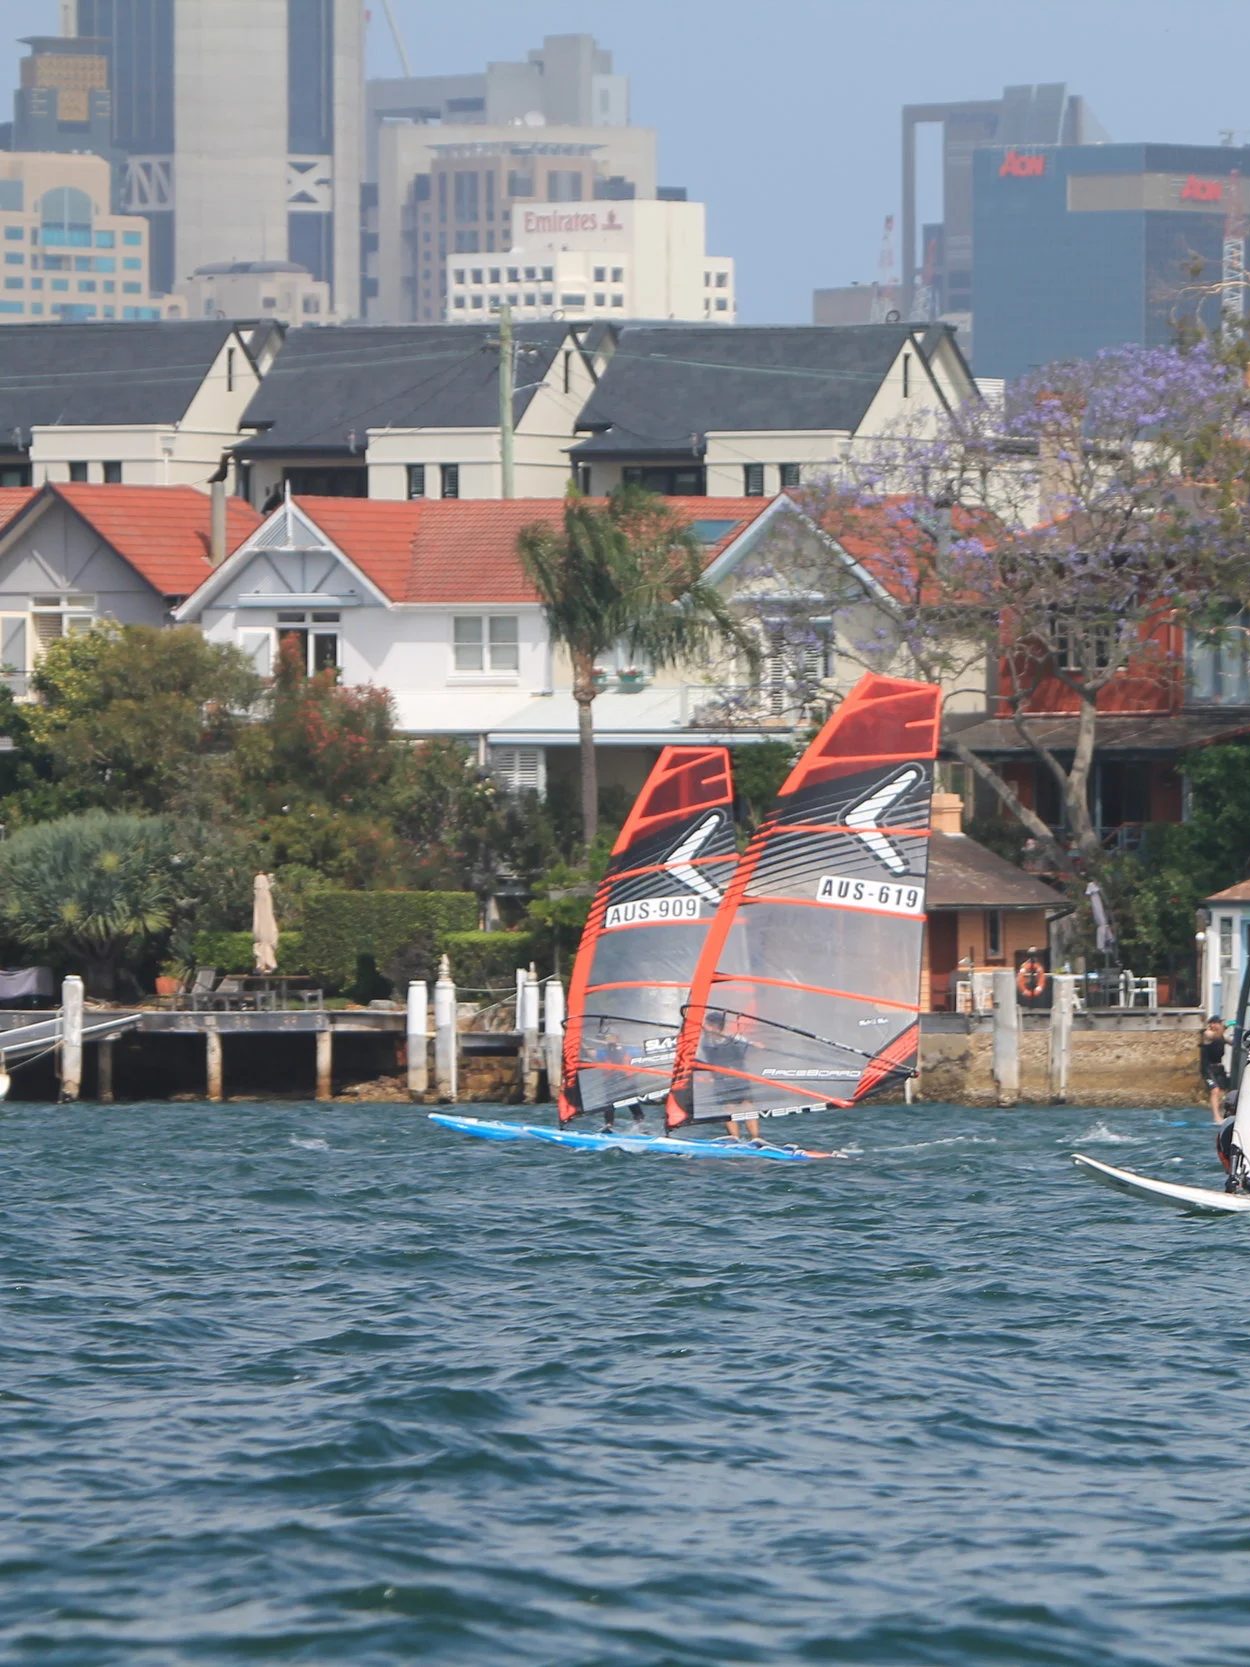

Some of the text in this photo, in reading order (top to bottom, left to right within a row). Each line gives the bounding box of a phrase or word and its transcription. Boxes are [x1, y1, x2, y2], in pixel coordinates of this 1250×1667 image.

[524, 210, 598, 233] Emirates
[821, 879, 919, 908] AUS-619
[609, 898, 697, 926] AUS-909
